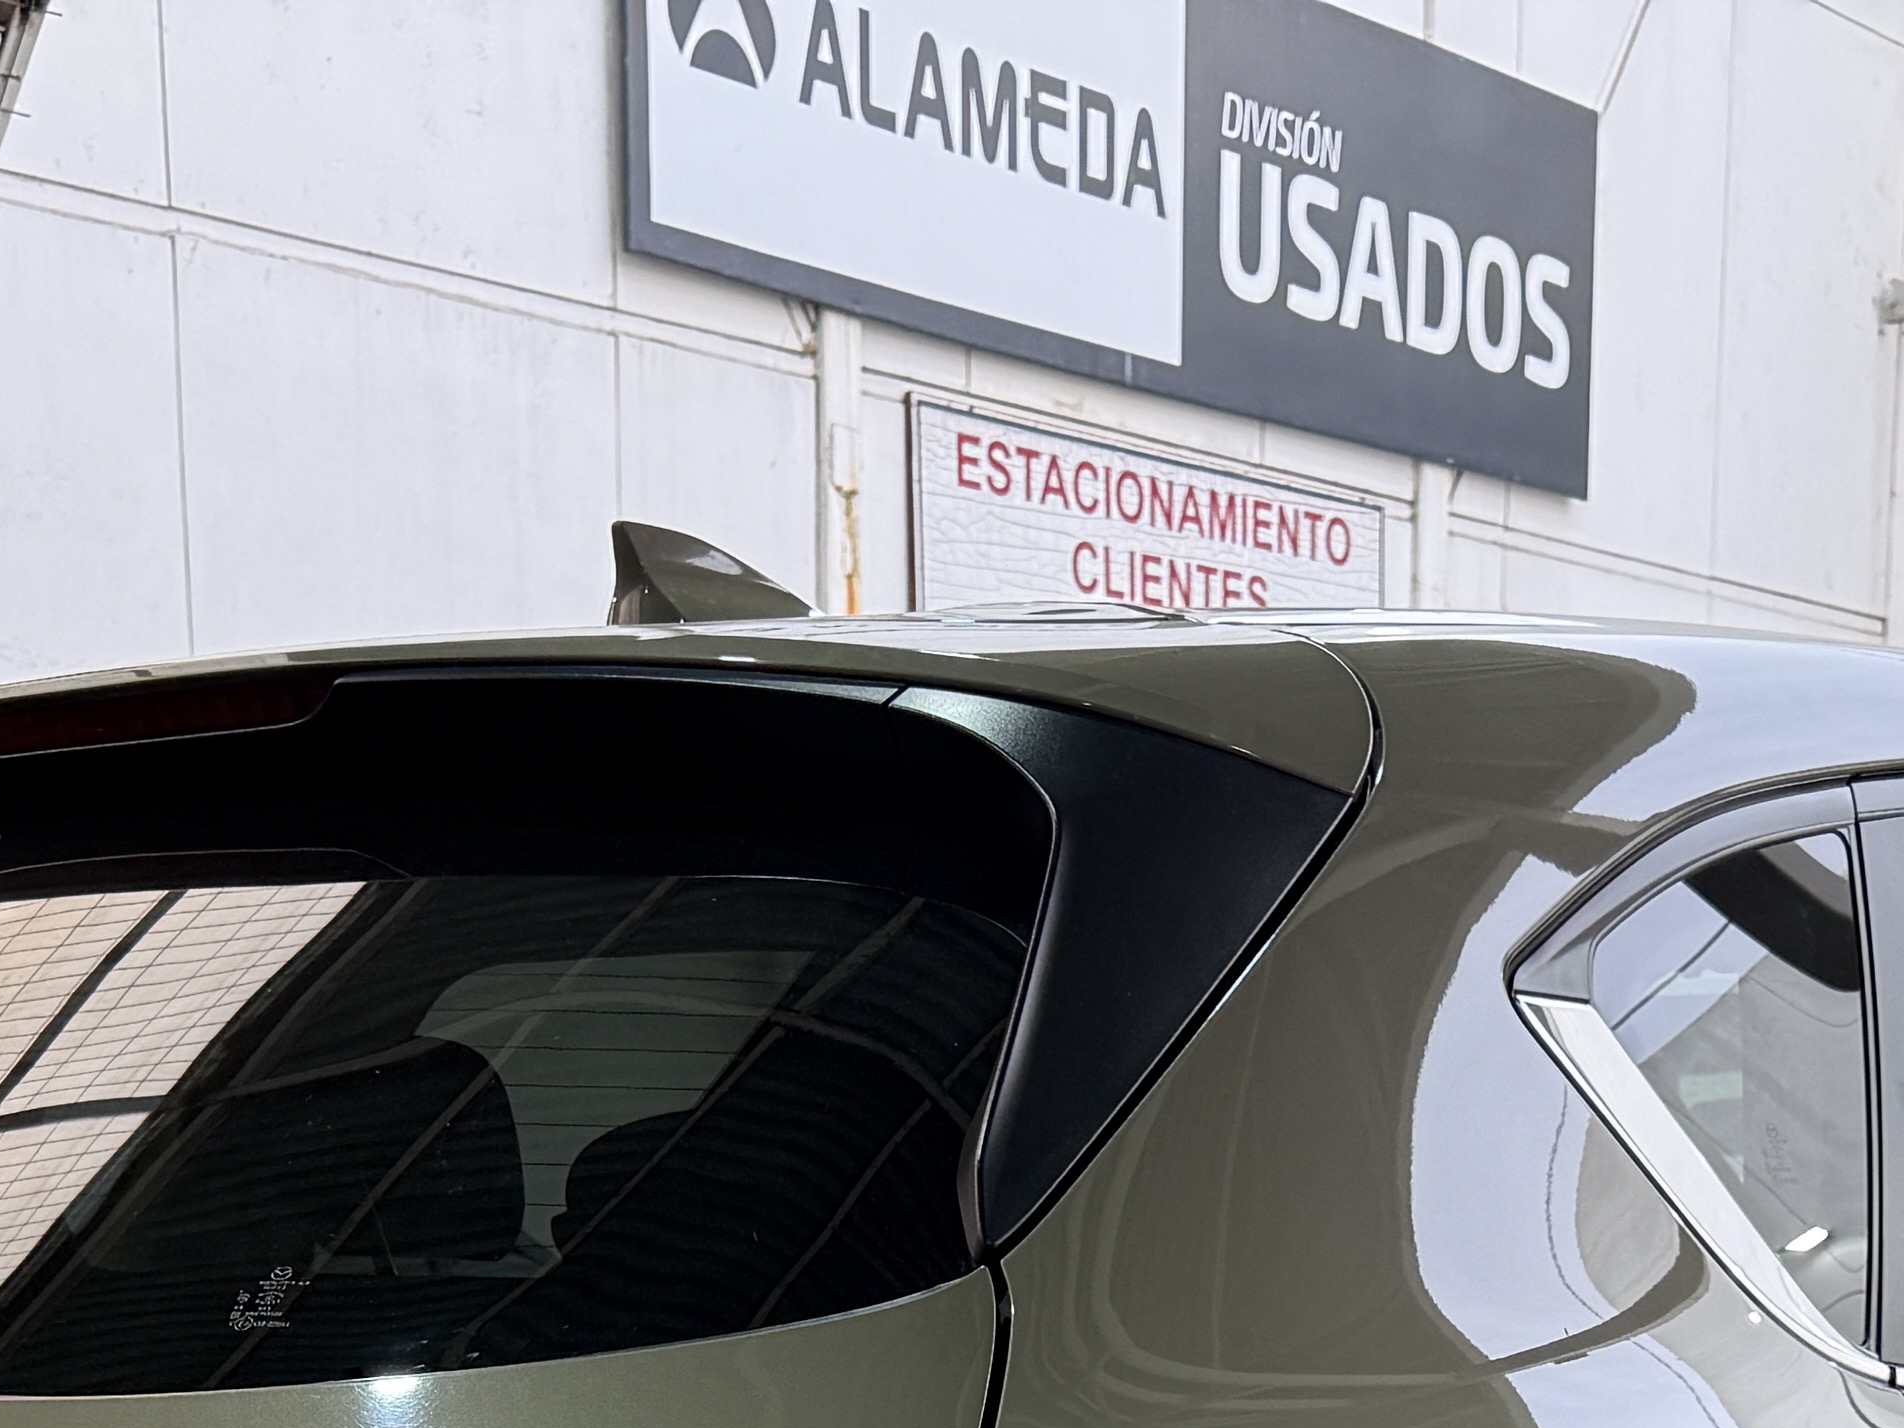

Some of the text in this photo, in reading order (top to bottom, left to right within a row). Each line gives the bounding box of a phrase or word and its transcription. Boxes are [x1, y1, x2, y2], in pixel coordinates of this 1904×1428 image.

[799, 0, 1166, 219] ALAMEDA
[1221, 91, 1343, 173] DIVISIÓN
[1219, 149, 1570, 389] USADOS
[956, 432, 1352, 566] ESTACIONAMIENTO
[1072, 540, 1268, 609] CLIENTES
